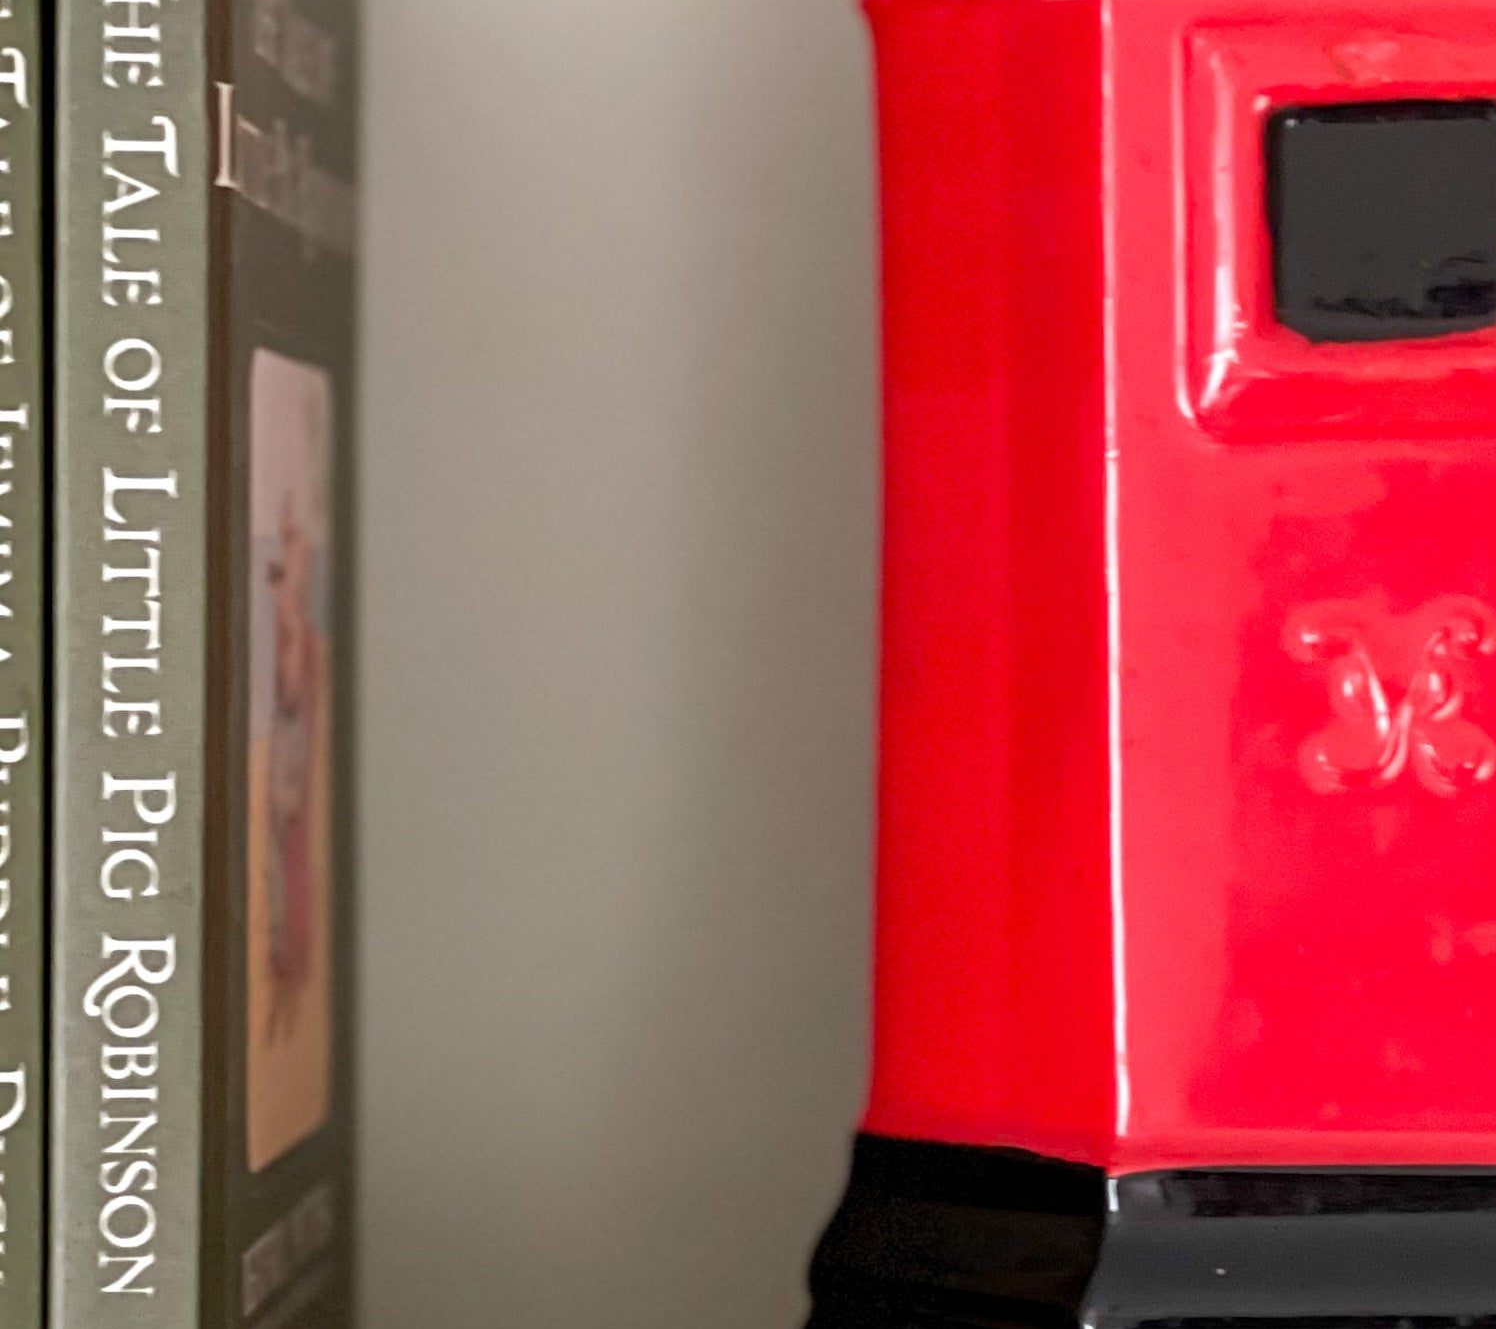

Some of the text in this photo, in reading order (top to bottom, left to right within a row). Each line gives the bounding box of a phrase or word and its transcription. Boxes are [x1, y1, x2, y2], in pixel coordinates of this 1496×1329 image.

[102, 115, 180, 307] TALE
[102, 338, 163, 434] OF
[101, 467, 179, 739] LITTLE
[100, 771, 177, 902] PIG
[82, 934, 177, 1296] ROBINSON
